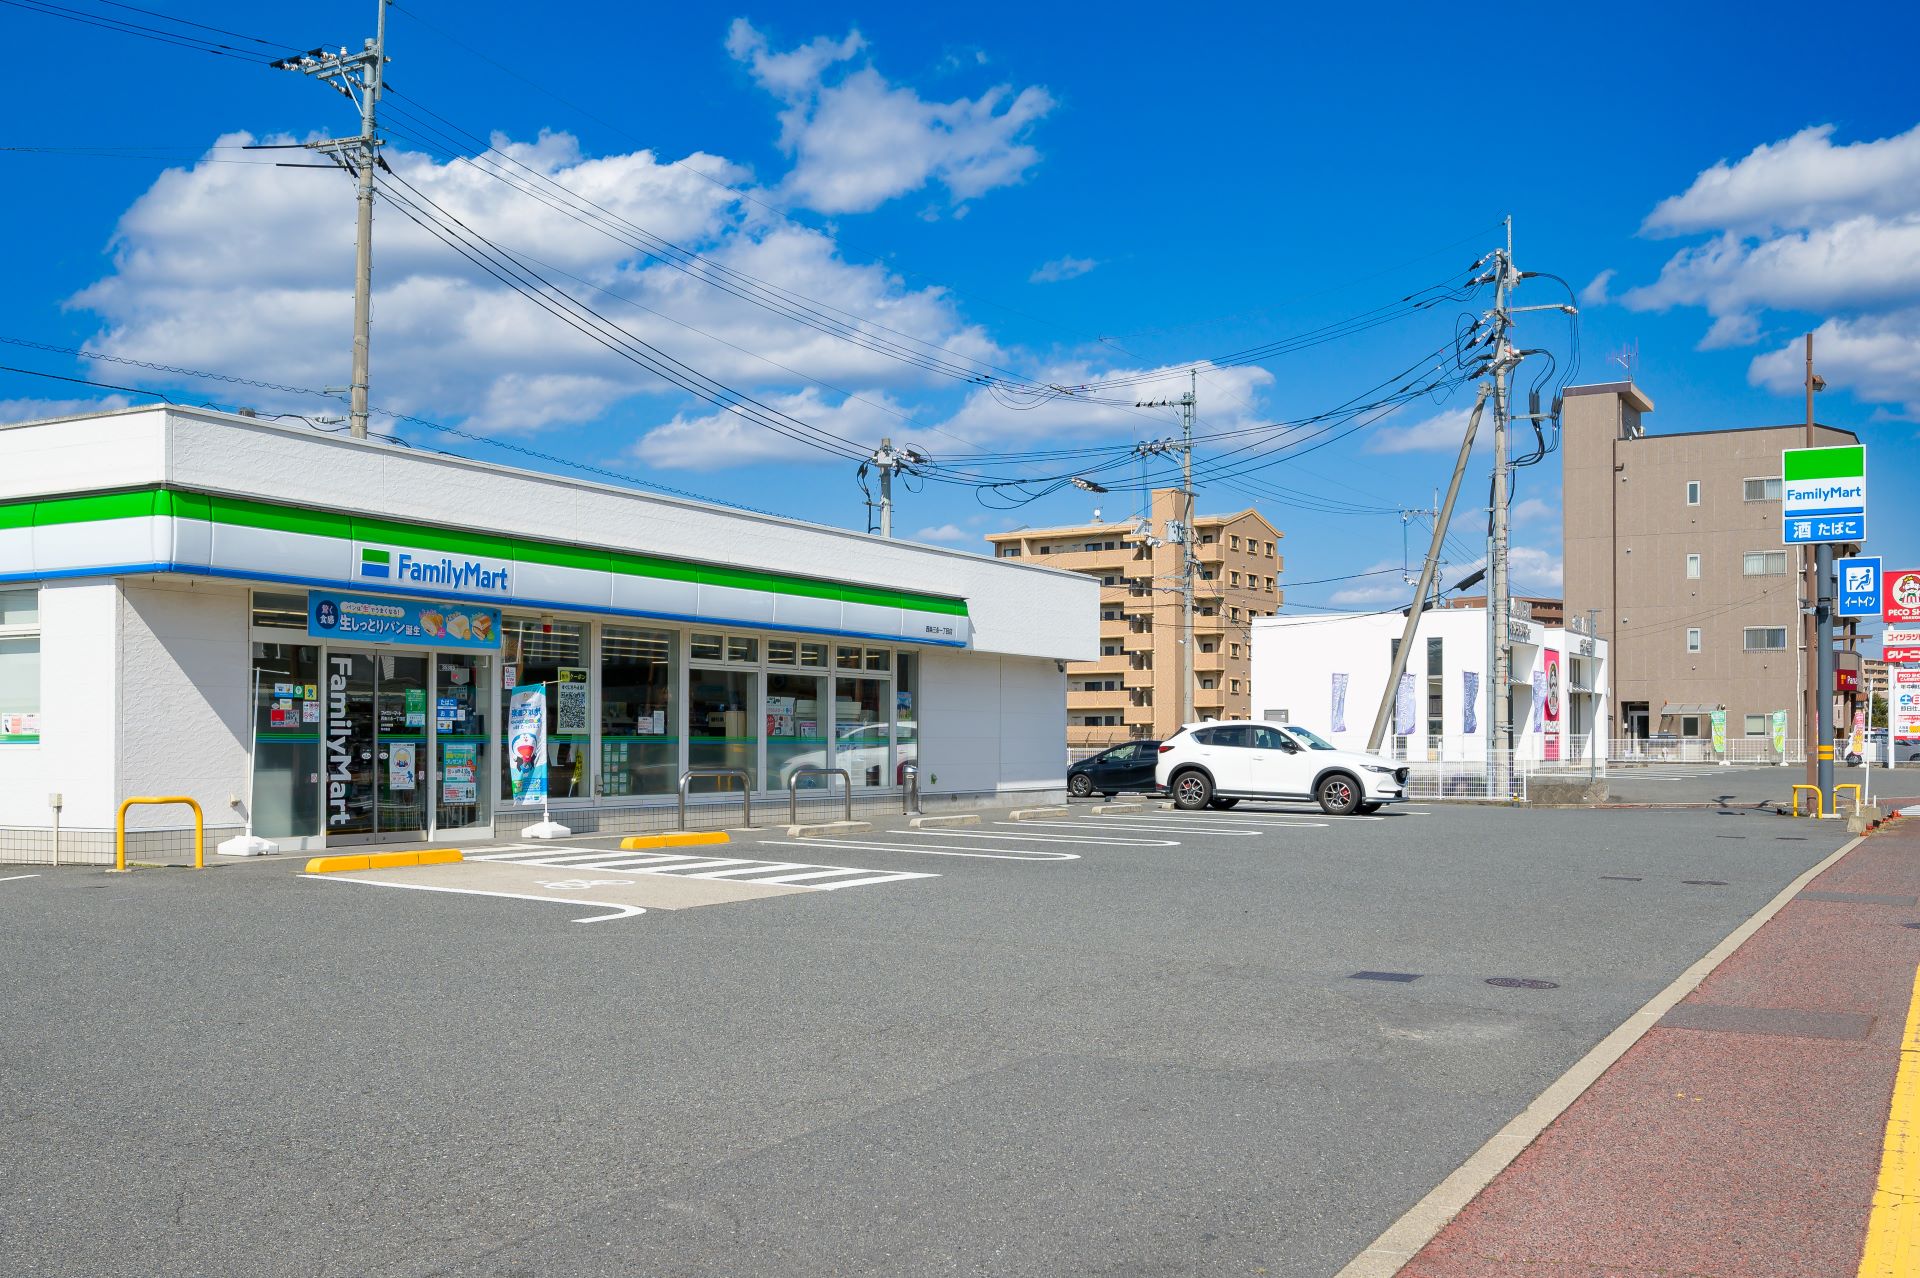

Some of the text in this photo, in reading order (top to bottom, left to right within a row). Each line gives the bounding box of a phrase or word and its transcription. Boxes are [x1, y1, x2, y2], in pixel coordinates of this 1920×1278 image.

[1787, 486, 1862, 502] FamilyMart
[1793, 521, 1857, 539] 酒 たばこ
[397, 553, 508, 590] FamilyMart
[1844, 595, 1876, 608] イートイン
[1888, 608, 1910, 616] PECO
[319, 614, 335, 625] 食感
[1887, 650, 1920, 660] クリーニ
[326, 657, 353, 825] FamilyMart
